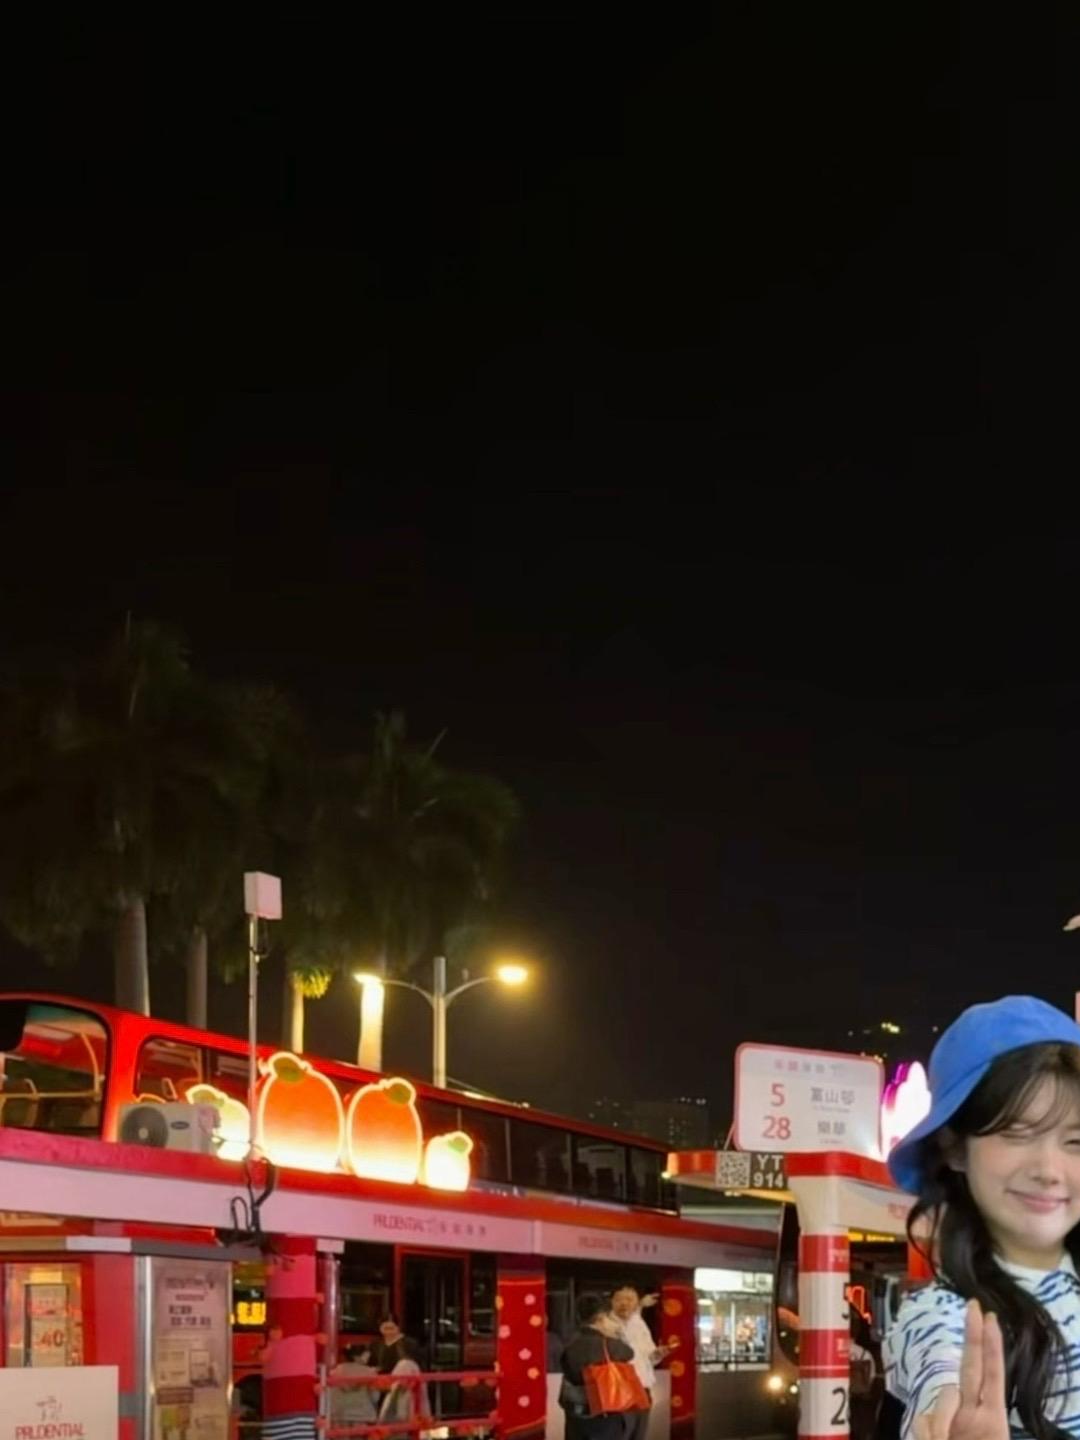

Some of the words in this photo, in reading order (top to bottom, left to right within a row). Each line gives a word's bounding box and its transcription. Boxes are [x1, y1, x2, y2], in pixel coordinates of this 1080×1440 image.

[771, 1083, 786, 1107] 5
[762, 1115, 792, 1140] 28
[756, 1153, 784, 1170] YT
[753, 1172, 785, 1189] 914
[831, 1387, 852, 1426] 2
[15, 1422, 85, 1440] PRUDENTIAL
